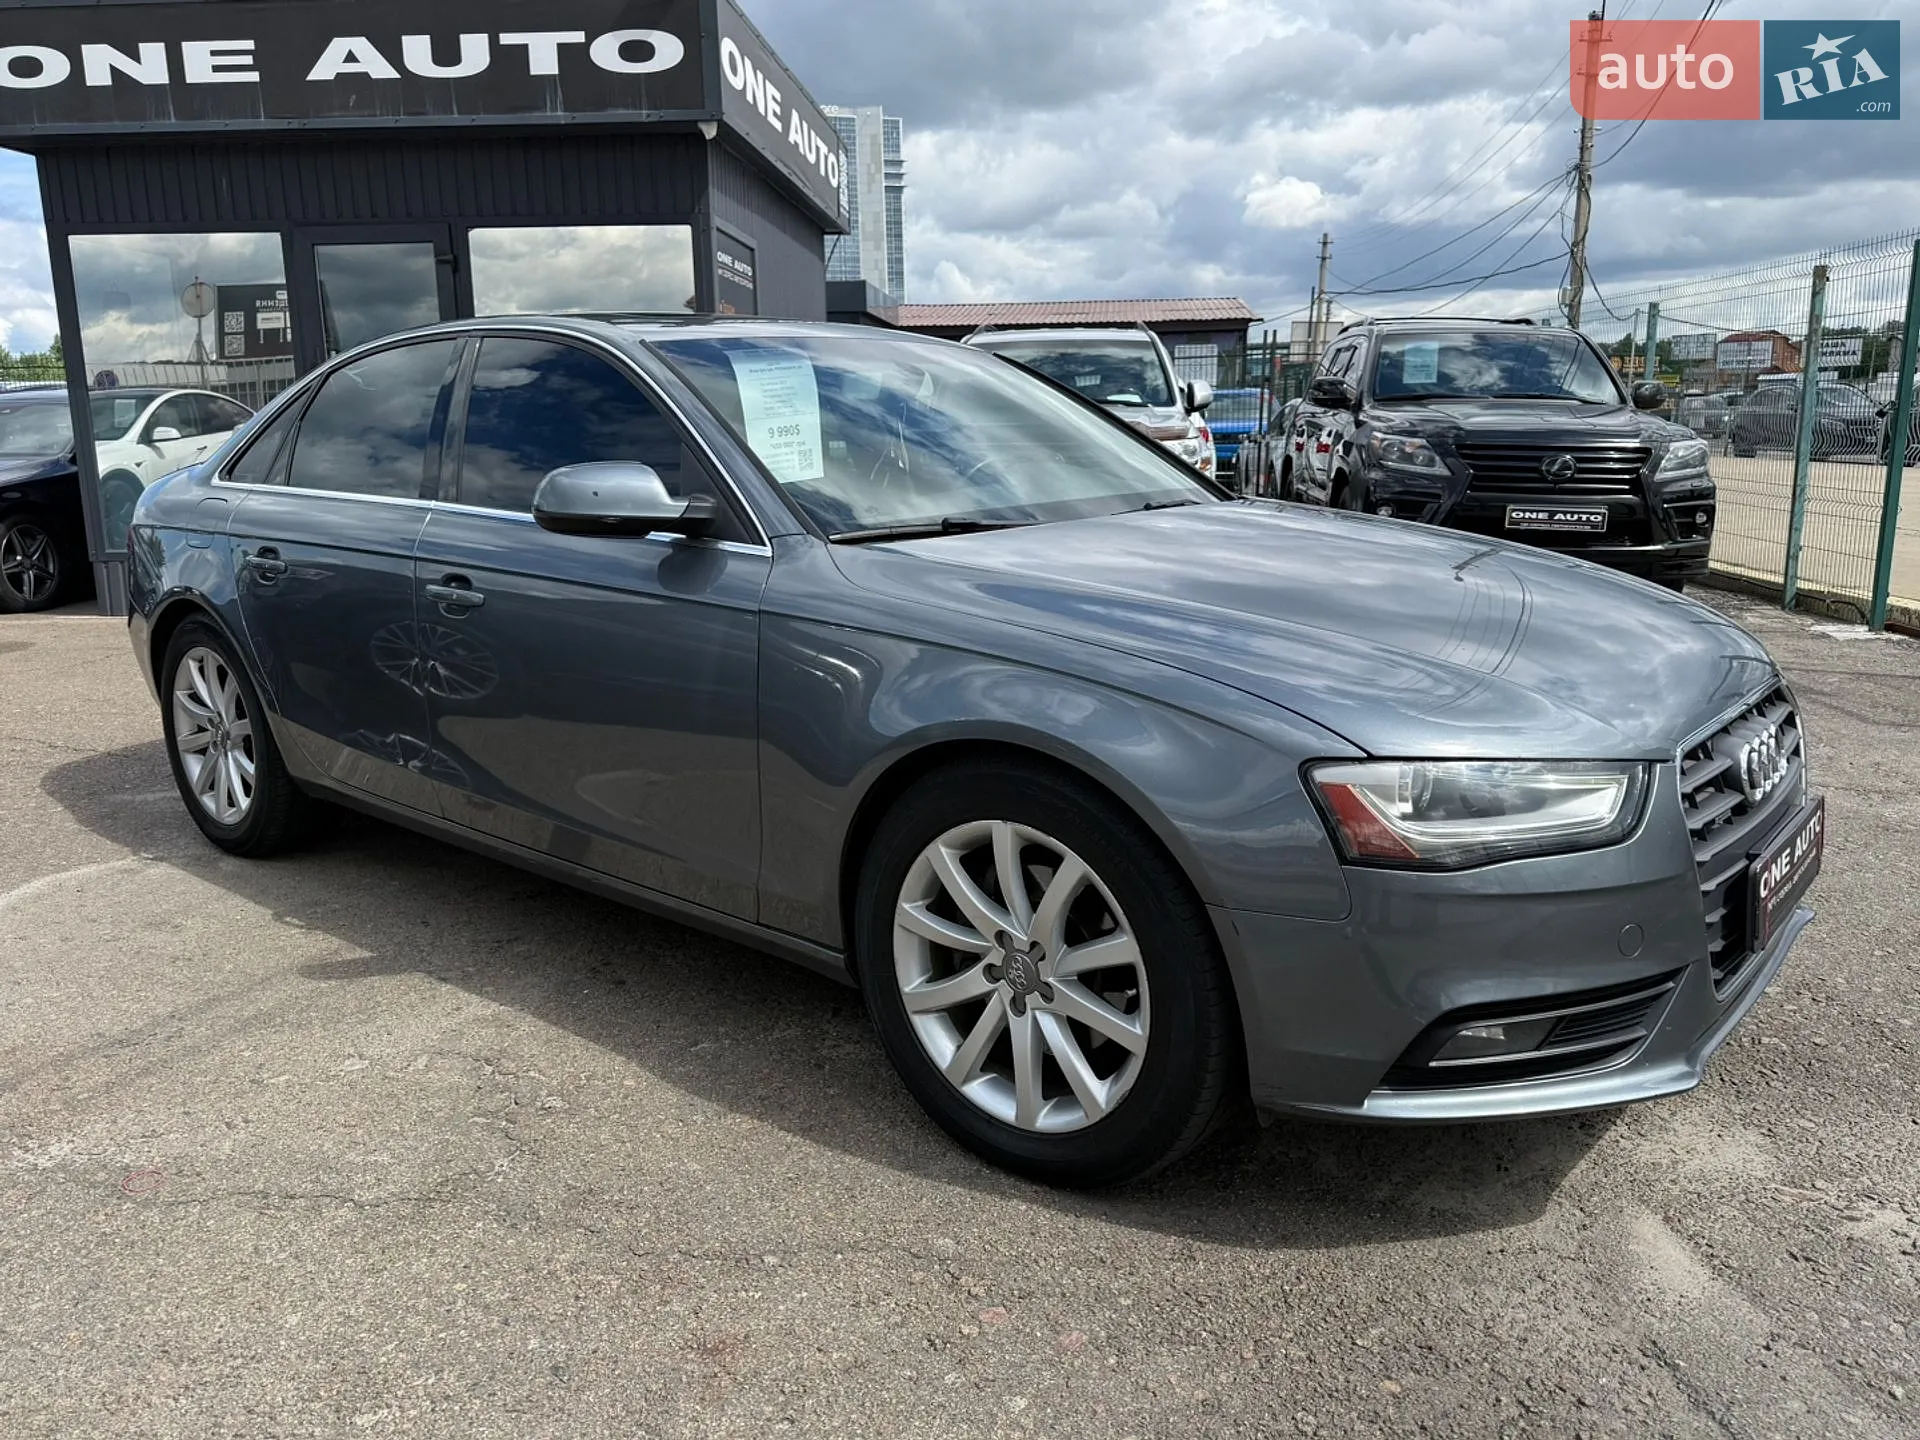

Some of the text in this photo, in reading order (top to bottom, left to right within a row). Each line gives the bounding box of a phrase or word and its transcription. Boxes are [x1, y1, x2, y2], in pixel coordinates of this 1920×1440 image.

[0, 29, 685, 89] ONE AUTO
[721, 37, 839, 188] ONE AUTO
[717, 251, 753, 275] ONE AUTO
[768, 427, 774, 439] 9
[1511, 511, 1603, 522] ONE AUTO
[1760, 809, 1821, 898] ONE AUTO
